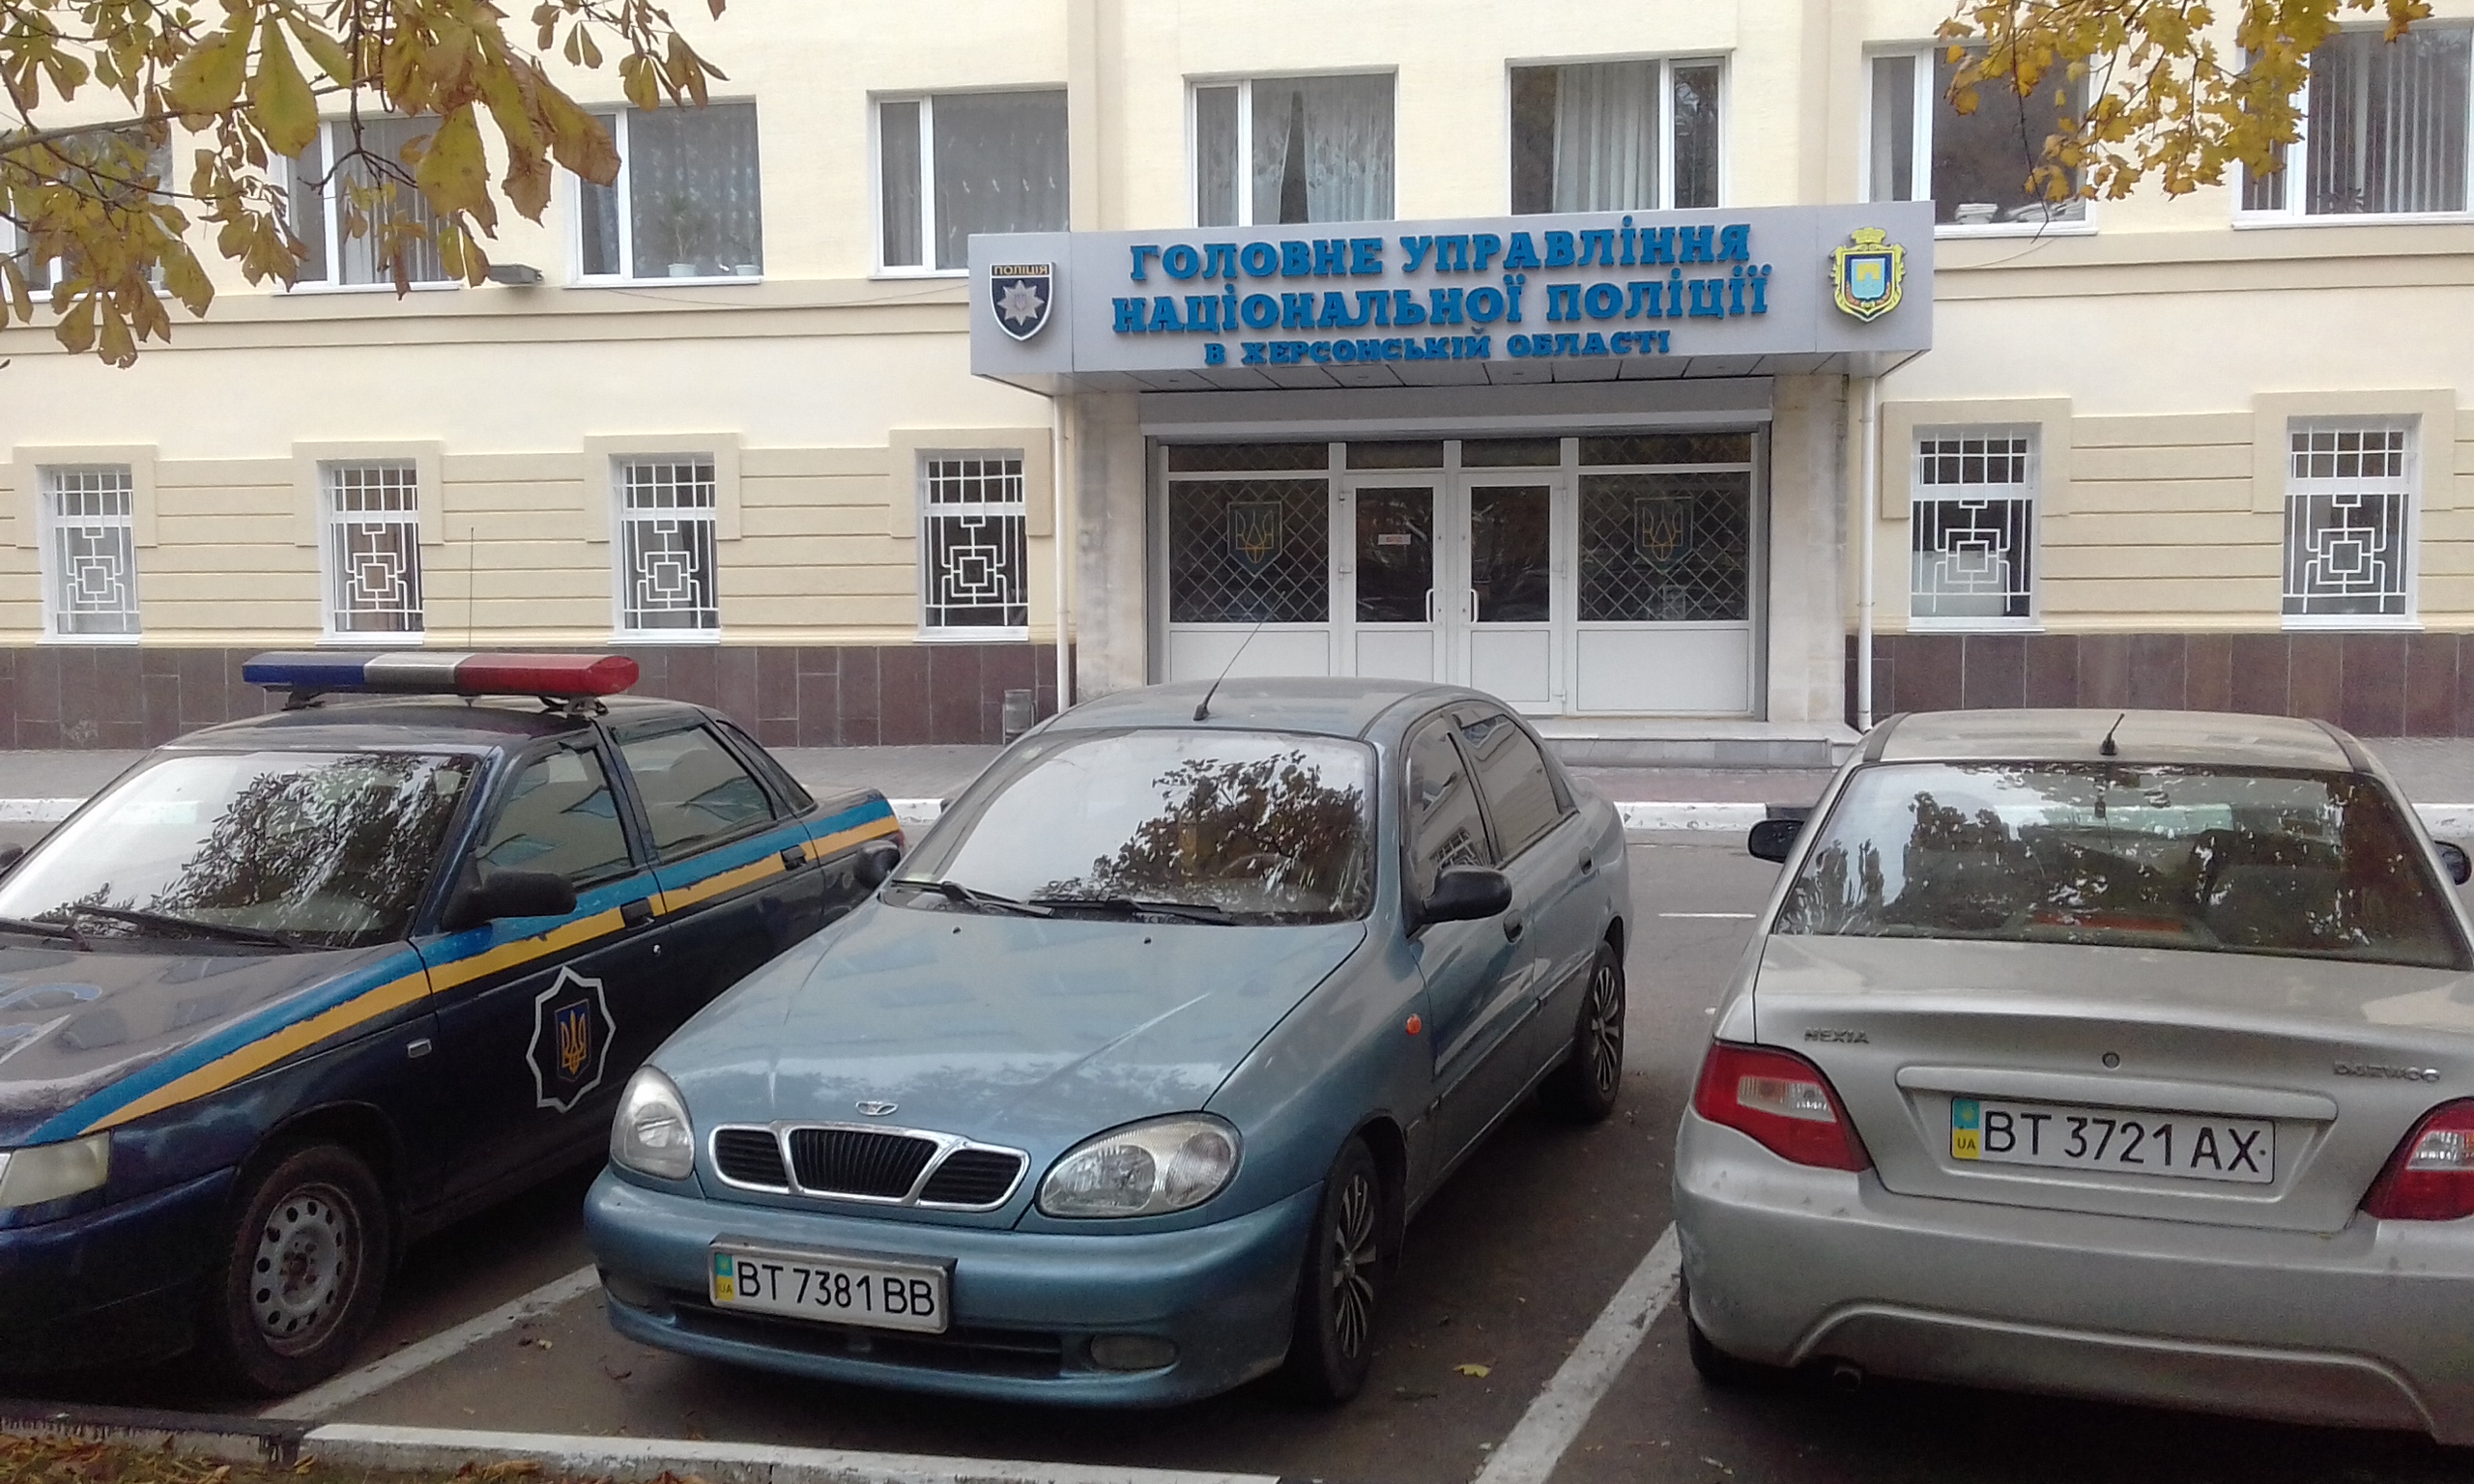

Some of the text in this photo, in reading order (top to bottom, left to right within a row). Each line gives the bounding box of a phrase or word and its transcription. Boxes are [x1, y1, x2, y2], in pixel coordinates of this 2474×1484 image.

[993, 266, 1049, 275] ПОЛІЦІЯ
[1130, 237, 1383, 281] ГОЛОВНЕ
[1204, 327, 1670, 365] В ХЕРСОНСЬКІЙ ОБЛАСТІ
[1803, 1027, 1870, 1044] NEXIA
[1957, 1136, 1976, 1150] UA
[2064, 1115, 2173, 1167] 3721
[2190, 1126, 2261, 1174] AX
[792, 1267, 872, 1312] 7381
[883, 1276, 935, 1317] BB
